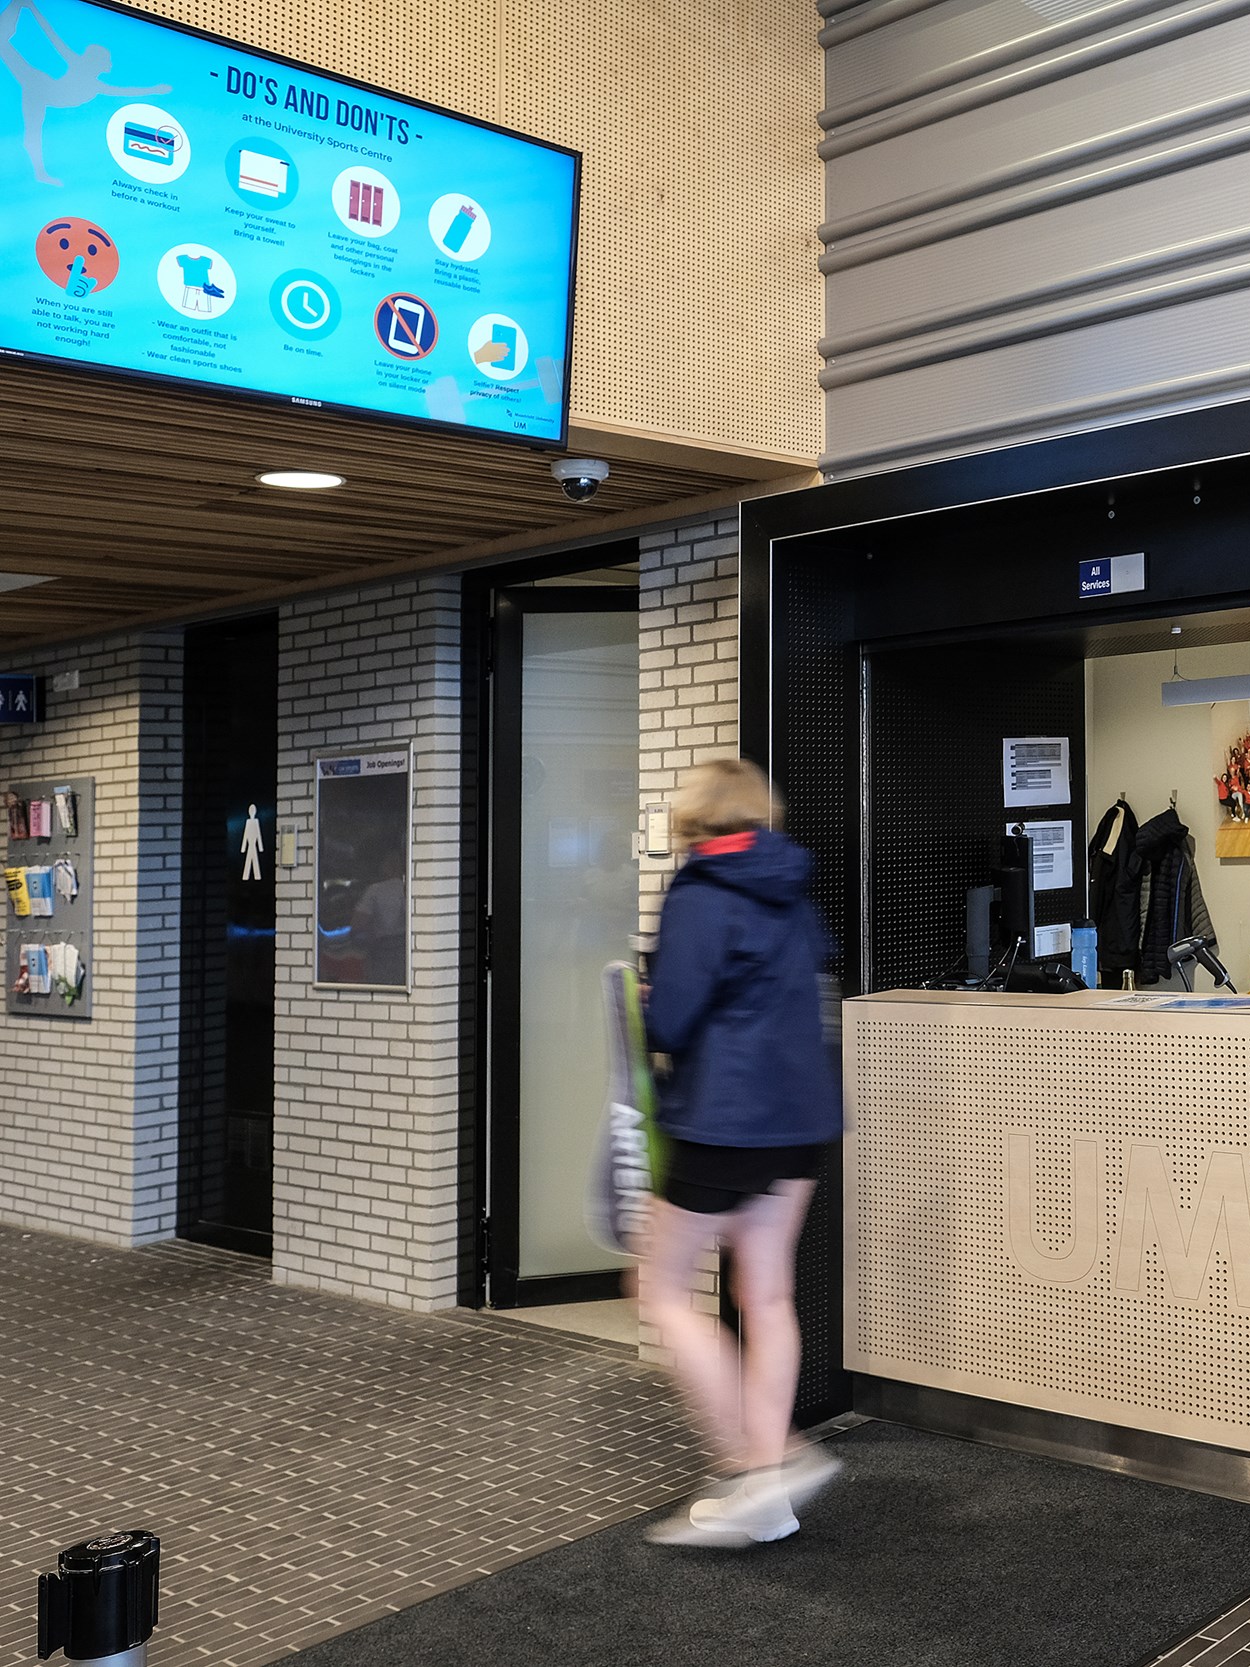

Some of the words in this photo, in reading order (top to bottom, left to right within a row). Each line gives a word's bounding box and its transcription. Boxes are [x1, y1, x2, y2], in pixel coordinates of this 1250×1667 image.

[226, 65, 278, 106] DO'S
[284, 84, 330, 121] AND
[336, 99, 410, 145] DON'TS
[241, 112, 253, 123] at
[254, 115, 272, 129] the
[274, 121, 326, 145] University
[327, 136, 359, 154] Sports
[360, 146, 393, 163] Centre
[111, 178, 143, 194] Always
[144, 186, 169, 201] check
[170, 192, 179, 201] in
[111, 189, 139, 203] before
[147, 199, 181, 213] workout
[224, 206, 245, 218] Keep
[245, 212, 264, 222] your
[265, 216, 287, 228] sweat
[287, 221, 296, 230] to
[233, 228, 255, 242] Bring
[255, 235, 262, 243] a
[243, 221, 277, 235] yourself.
[327, 231, 349, 243] Leave
[349, 237, 366, 246] your
[367, 239, 382, 251] bag,
[383, 244, 399, 254] coat
[330, 242, 344, 252] and
[345, 245, 363, 257] other
[364, 250, 395, 263] personal
[333, 252, 372, 269] belongings
[373, 261, 380, 270] in
[381, 263, 393, 273] the
[434, 258, 450, 269] Stay
[349, 266, 376, 279] lockers
[434, 267, 452, 279] Bring
[433, 277, 462, 290] reusable
[462, 283, 481, 295] bottle
[35, 296, 61, 308] When
[62, 302, 80, 312] you
[81, 305, 96, 315] are
[97, 308, 114, 318] still
[31, 307, 51, 318] able
[52, 311, 62, 320] to
[63, 313, 82, 324] talk,
[83, 317, 100, 327] you
[101, 320, 116, 330] are
[36, 319, 52, 329] not
[53, 322, 89, 337] working
[90, 328, 110, 340] hard
[156, 319, 178, 331] Wear
[179, 323, 190, 333] an
[191, 325, 213, 337] outfit
[213, 330, 229, 340] that
[230, 332, 238, 342] is
[54, 334, 91, 348] enough!
[162, 331, 213, 349] comfortable,
[213, 341, 227, 351] not
[170, 343, 216, 359] fashionable
[283, 343, 294, 352] Be
[294, 345, 305, 354] on
[305, 347, 324, 358] time.
[146, 350, 168, 361] Wear
[168, 353, 192, 365] clean
[192, 357, 218, 370] sports
[218, 362, 243, 374] shoes
[373, 359, 395, 369] Leave
[394, 364, 411, 374] your
[411, 365, 433, 376] phone
[375, 369, 384, 377] in
[383, 370, 400, 381] your
[400, 372, 422, 384] locker
[377, 380, 388, 388] on
[388, 380, 407, 391] silent
[407, 383, 427, 395] mode
[469, 389, 493, 400] privacy
[493, 391, 500, 400] of
[495, 383, 520, 395] Respect
[291, 396, 323, 408] SAMSUNG
[513, 421, 527, 430] UM
[1090, 565, 1101, 577] All
[1081, 579, 1111, 592] Services
[366, 760, 376, 769] Job
[376, 758, 406, 769] Openings!
